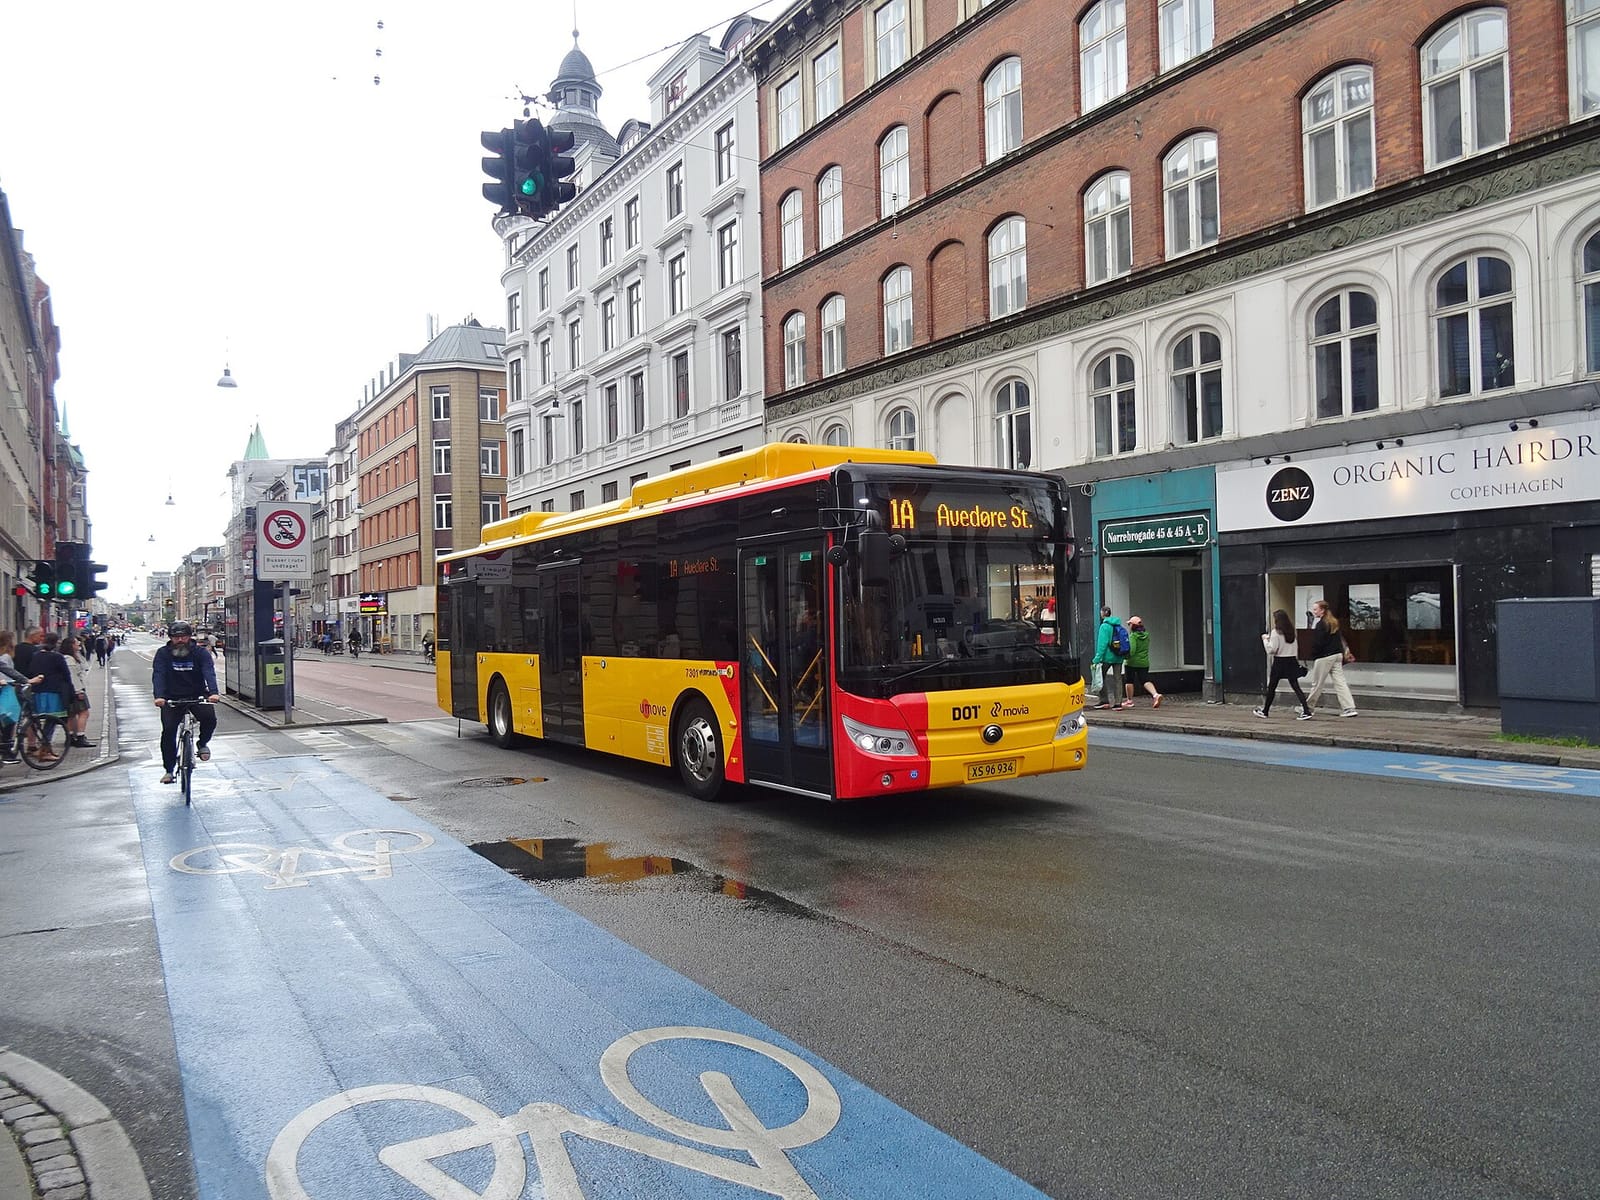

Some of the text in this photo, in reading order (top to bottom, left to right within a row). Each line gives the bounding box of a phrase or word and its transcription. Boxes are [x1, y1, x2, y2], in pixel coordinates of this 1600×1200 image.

[1333, 434, 1600, 486] ORGANIC HAIRDR
[1271, 486, 1311, 503] ZENZ
[1450, 477, 1564, 500] COPENHAGEN
[890, 498, 1033, 529] 1A Avedøre St.
[1156, 527, 1166, 539] 45
[1166, 527, 1174, 538] &
[1174, 525, 1184, 537] 45
[1184, 524, 1191, 537] A
[1197, 523, 1204, 536] E
[952, 705, 981, 721] DOT
[1003, 704, 1029, 717] movia
[971, 761, 1013, 778] XS 96 934
